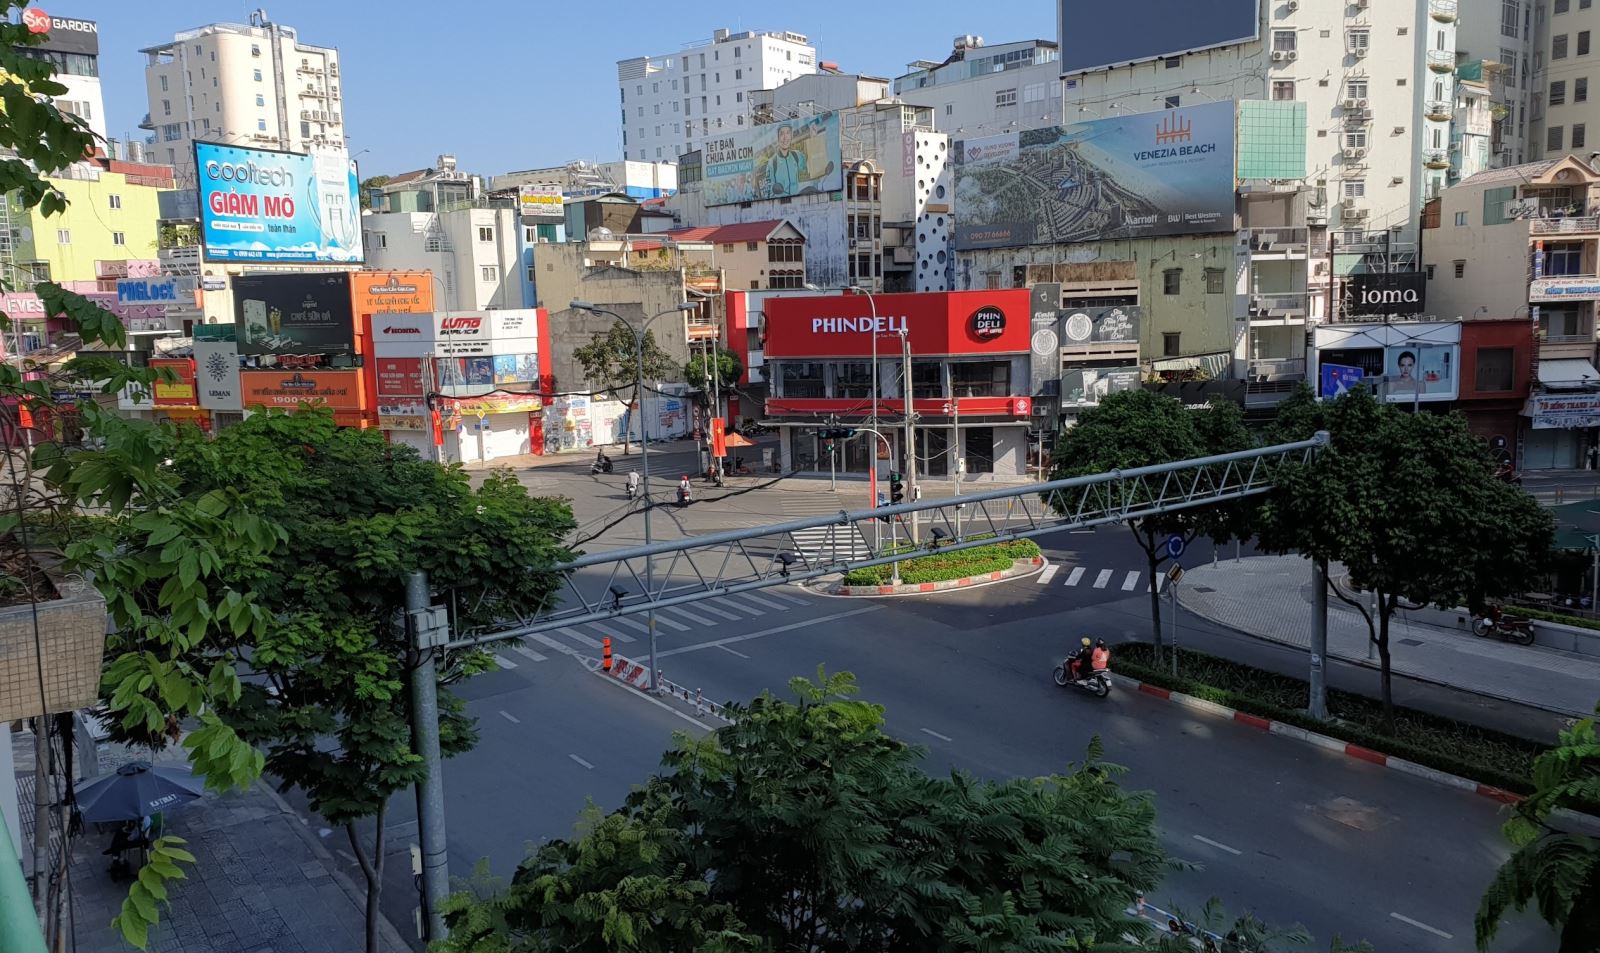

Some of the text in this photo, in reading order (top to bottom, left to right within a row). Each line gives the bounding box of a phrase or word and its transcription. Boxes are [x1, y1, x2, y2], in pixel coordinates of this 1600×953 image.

[52, 18, 97, 32] GARDEN
[1134, 143, 1216, 161] VENEZIA BEACH
[207, 160, 294, 188] cooltech
[1123, 214, 1158, 225] Marriott
[1361, 284, 1419, 304] ioma
[977, 312, 1001, 320] PHIN
[812, 315, 907, 333] PHINDELI
[977, 320, 1001, 329] DELI
[440, 328, 479, 336] SERVICE
[208, 389, 232, 398] LEMAN
[272, 396, 298, 404] 1900
